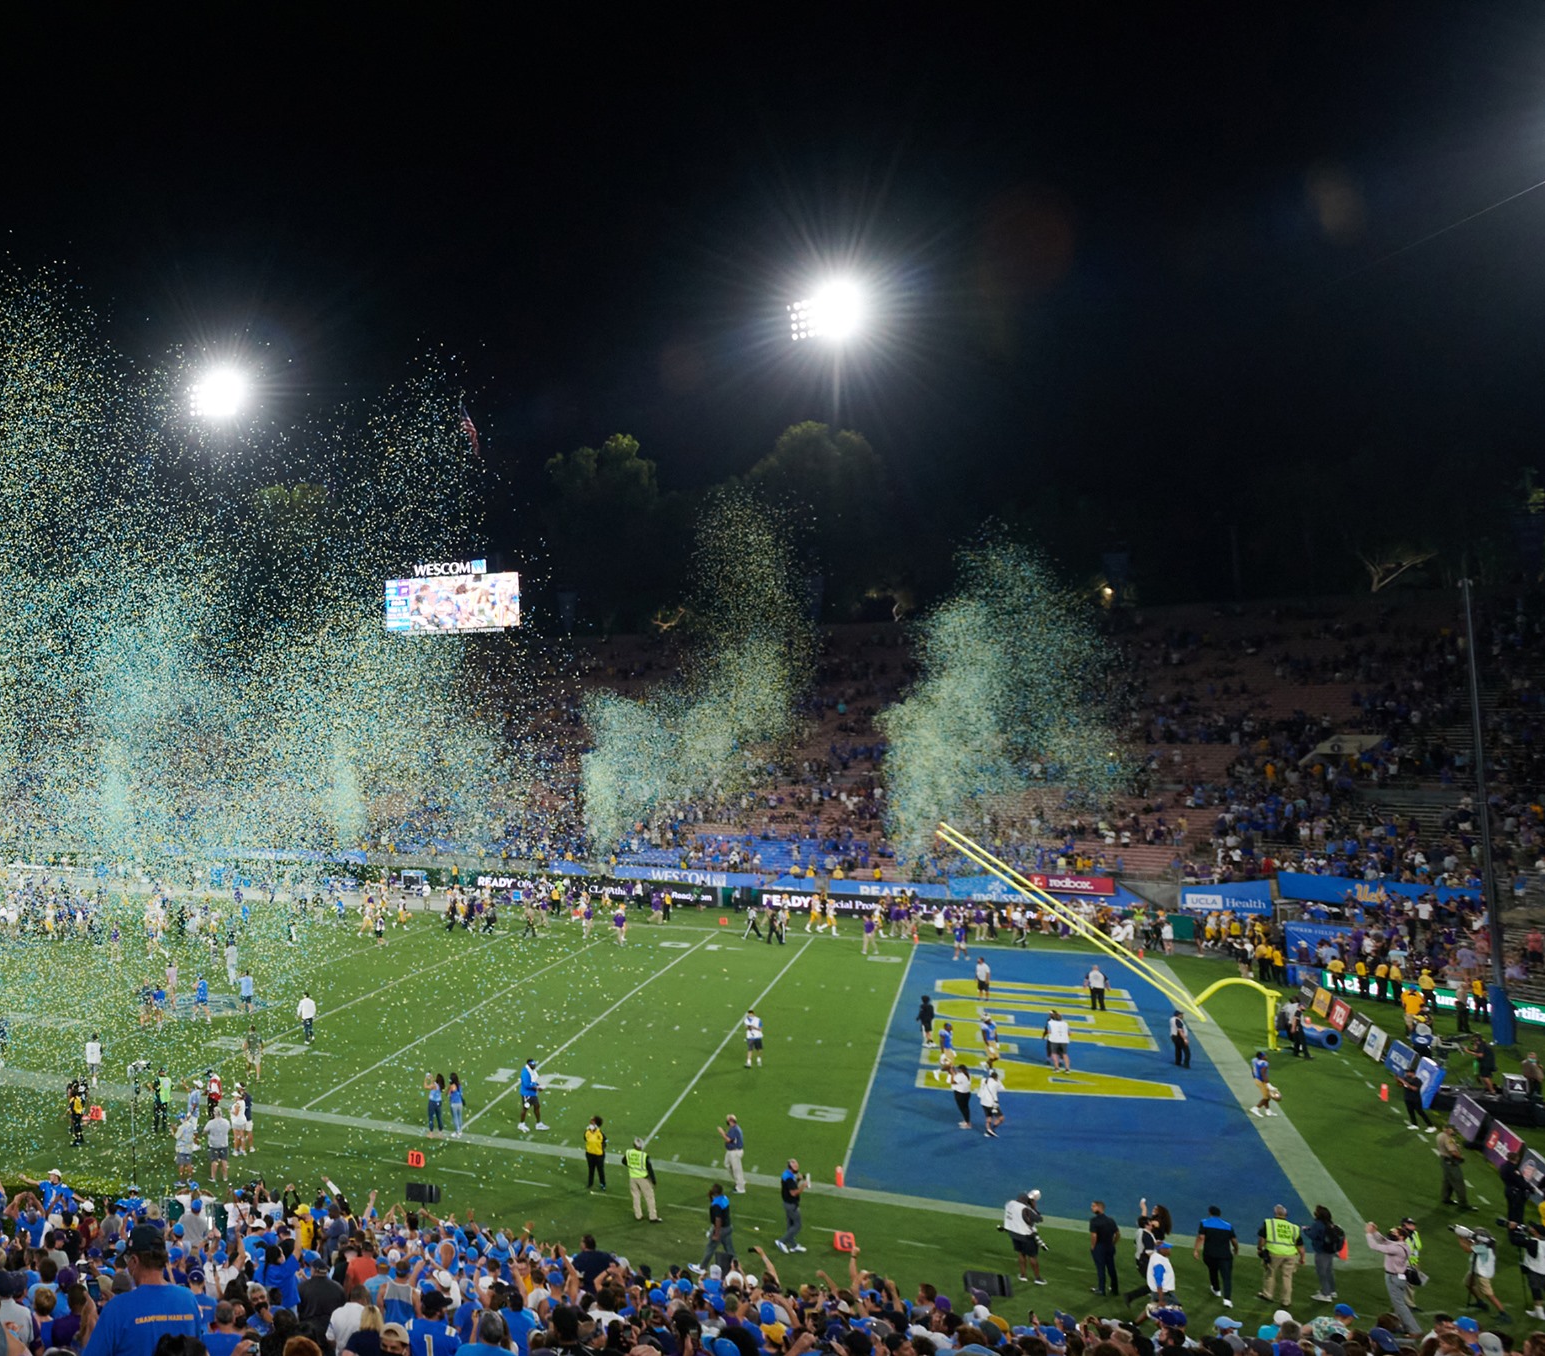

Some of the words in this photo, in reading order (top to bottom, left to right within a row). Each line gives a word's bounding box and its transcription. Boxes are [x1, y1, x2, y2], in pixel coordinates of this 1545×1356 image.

[413, 561, 470, 577] WESCOM
[477, 876, 513, 888] READY
[652, 869, 711, 887] WESCOM
[762, 893, 812, 908] REDY
[1191, 897, 1218, 906] UCLA
[1225, 898, 1266, 910] Health
[1332, 1005, 1347, 1026] TCL
[788, 1103, 849, 1123] G
[410, 1153, 422, 1165] 10
[839, 1234, 853, 1249] G
